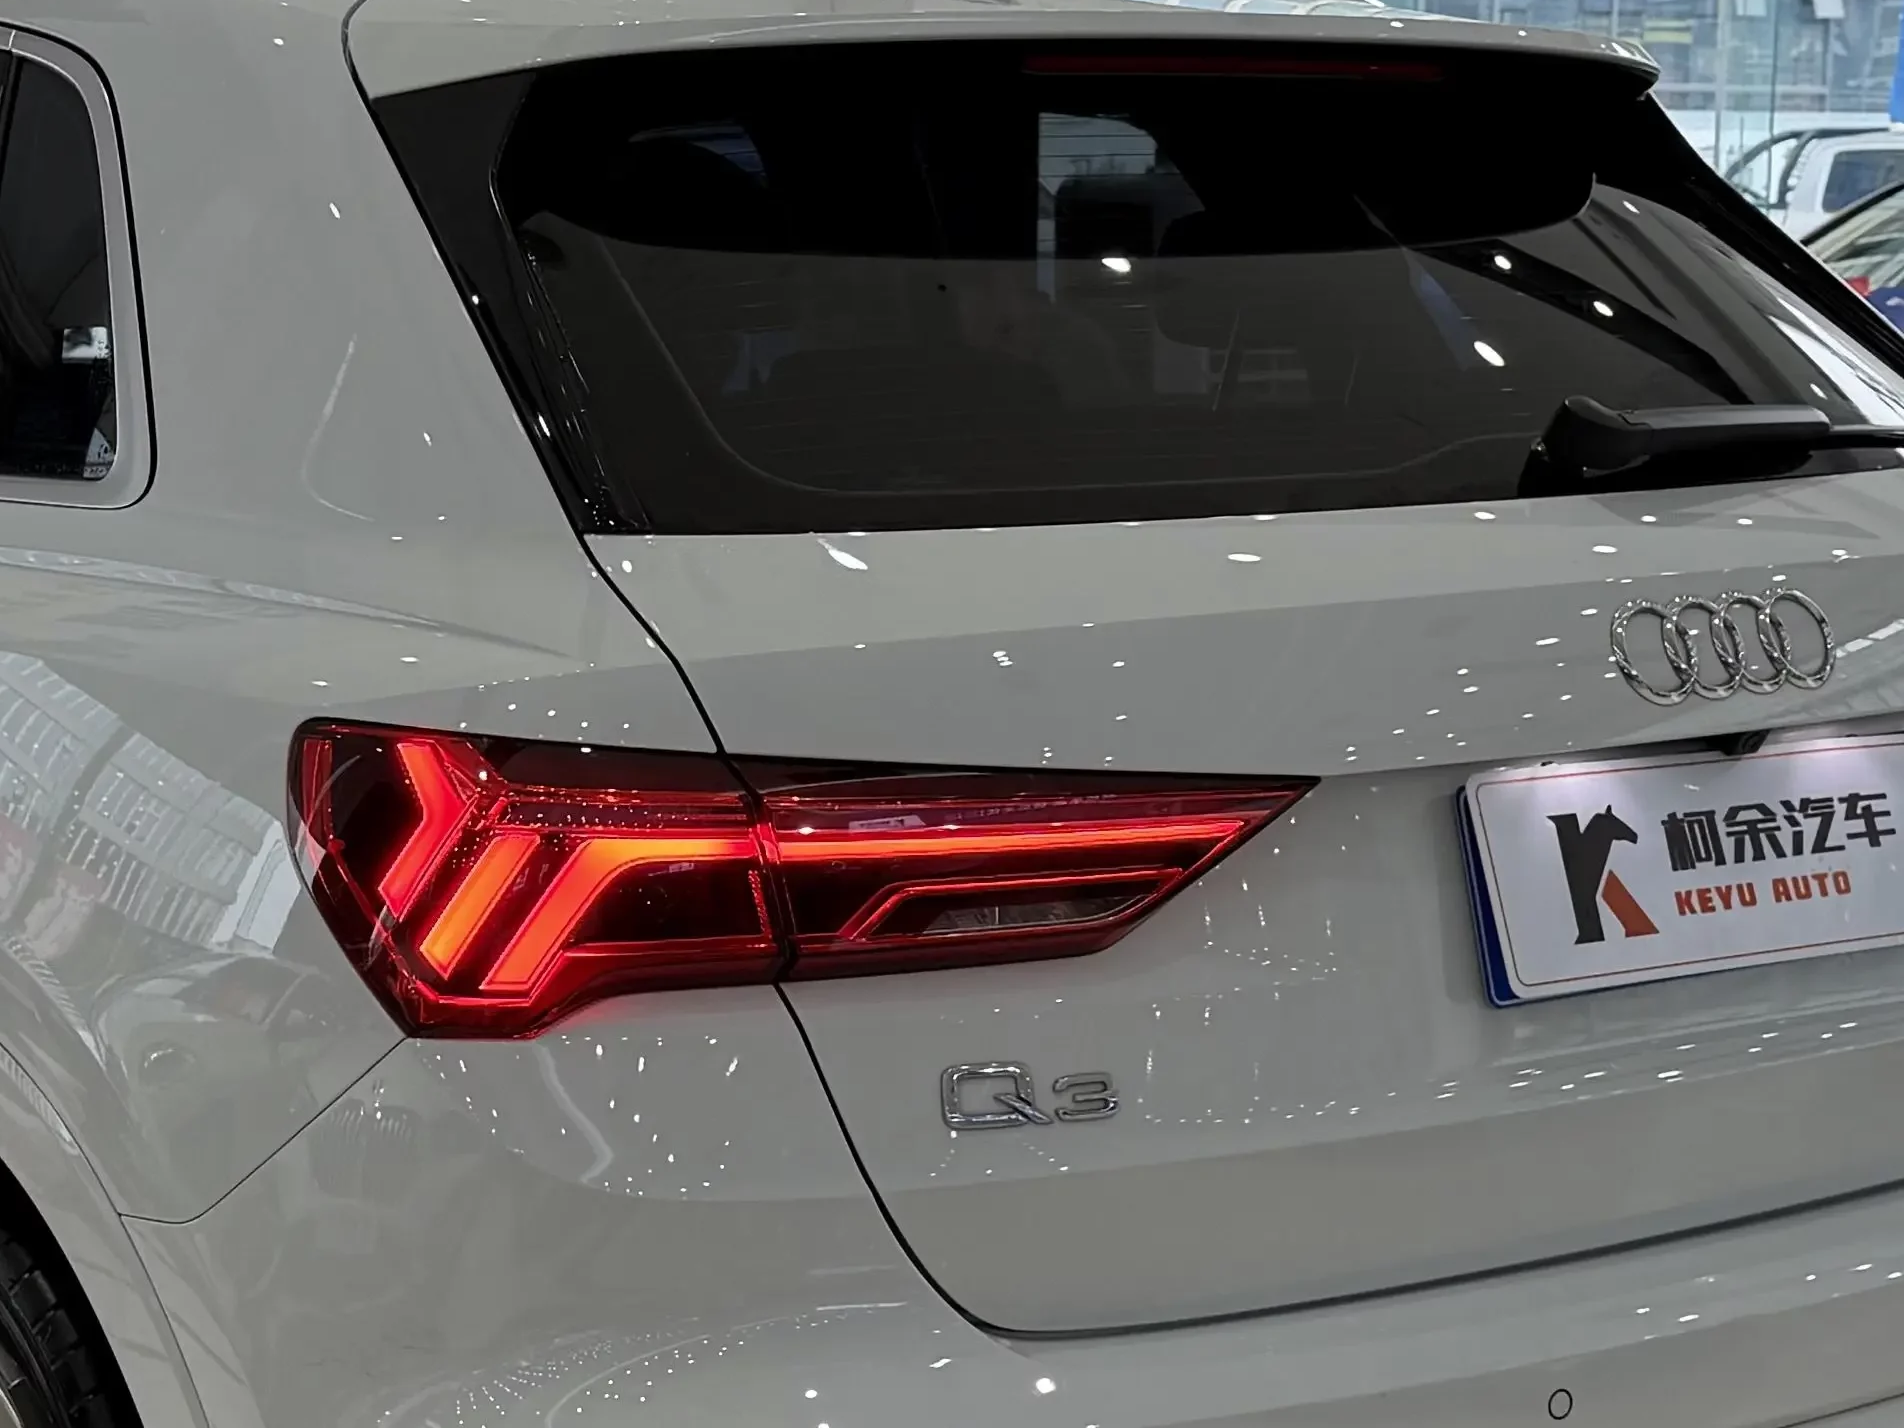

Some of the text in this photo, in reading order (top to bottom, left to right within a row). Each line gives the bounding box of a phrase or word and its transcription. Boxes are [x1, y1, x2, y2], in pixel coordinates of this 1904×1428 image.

[1660, 792, 1897, 872] 柯余汽车
[1674, 870, 1852, 917] KEYU AUTO
[940, 1061, 1122, 1131] Q3
